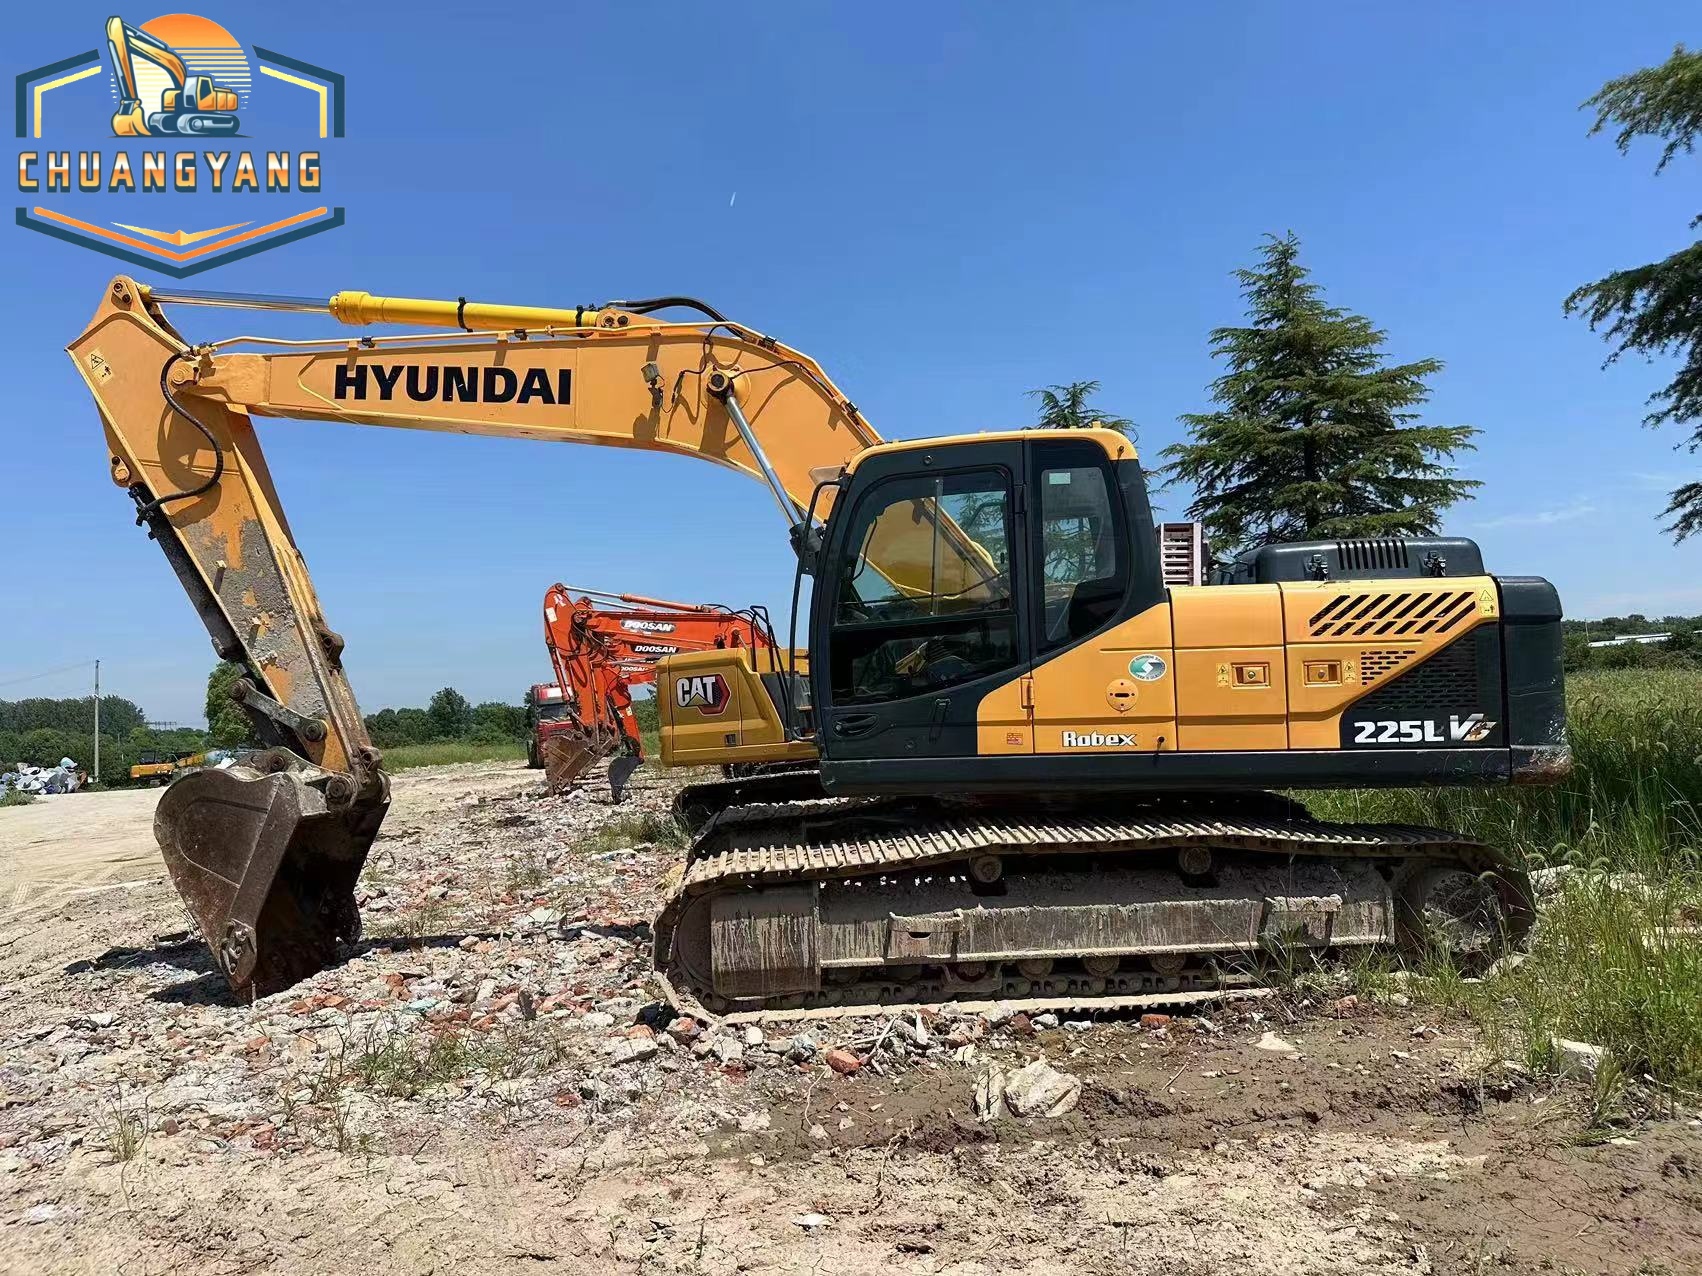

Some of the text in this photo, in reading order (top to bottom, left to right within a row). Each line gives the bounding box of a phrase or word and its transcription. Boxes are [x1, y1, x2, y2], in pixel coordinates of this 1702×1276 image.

[334, 364, 572, 405] HYUNDAI
[624, 620, 672, 632] DOOSAN
[634, 645, 677, 653] DOOSAN
[676, 676, 716, 707] CAT
[1062, 730, 1137, 747] Robex
